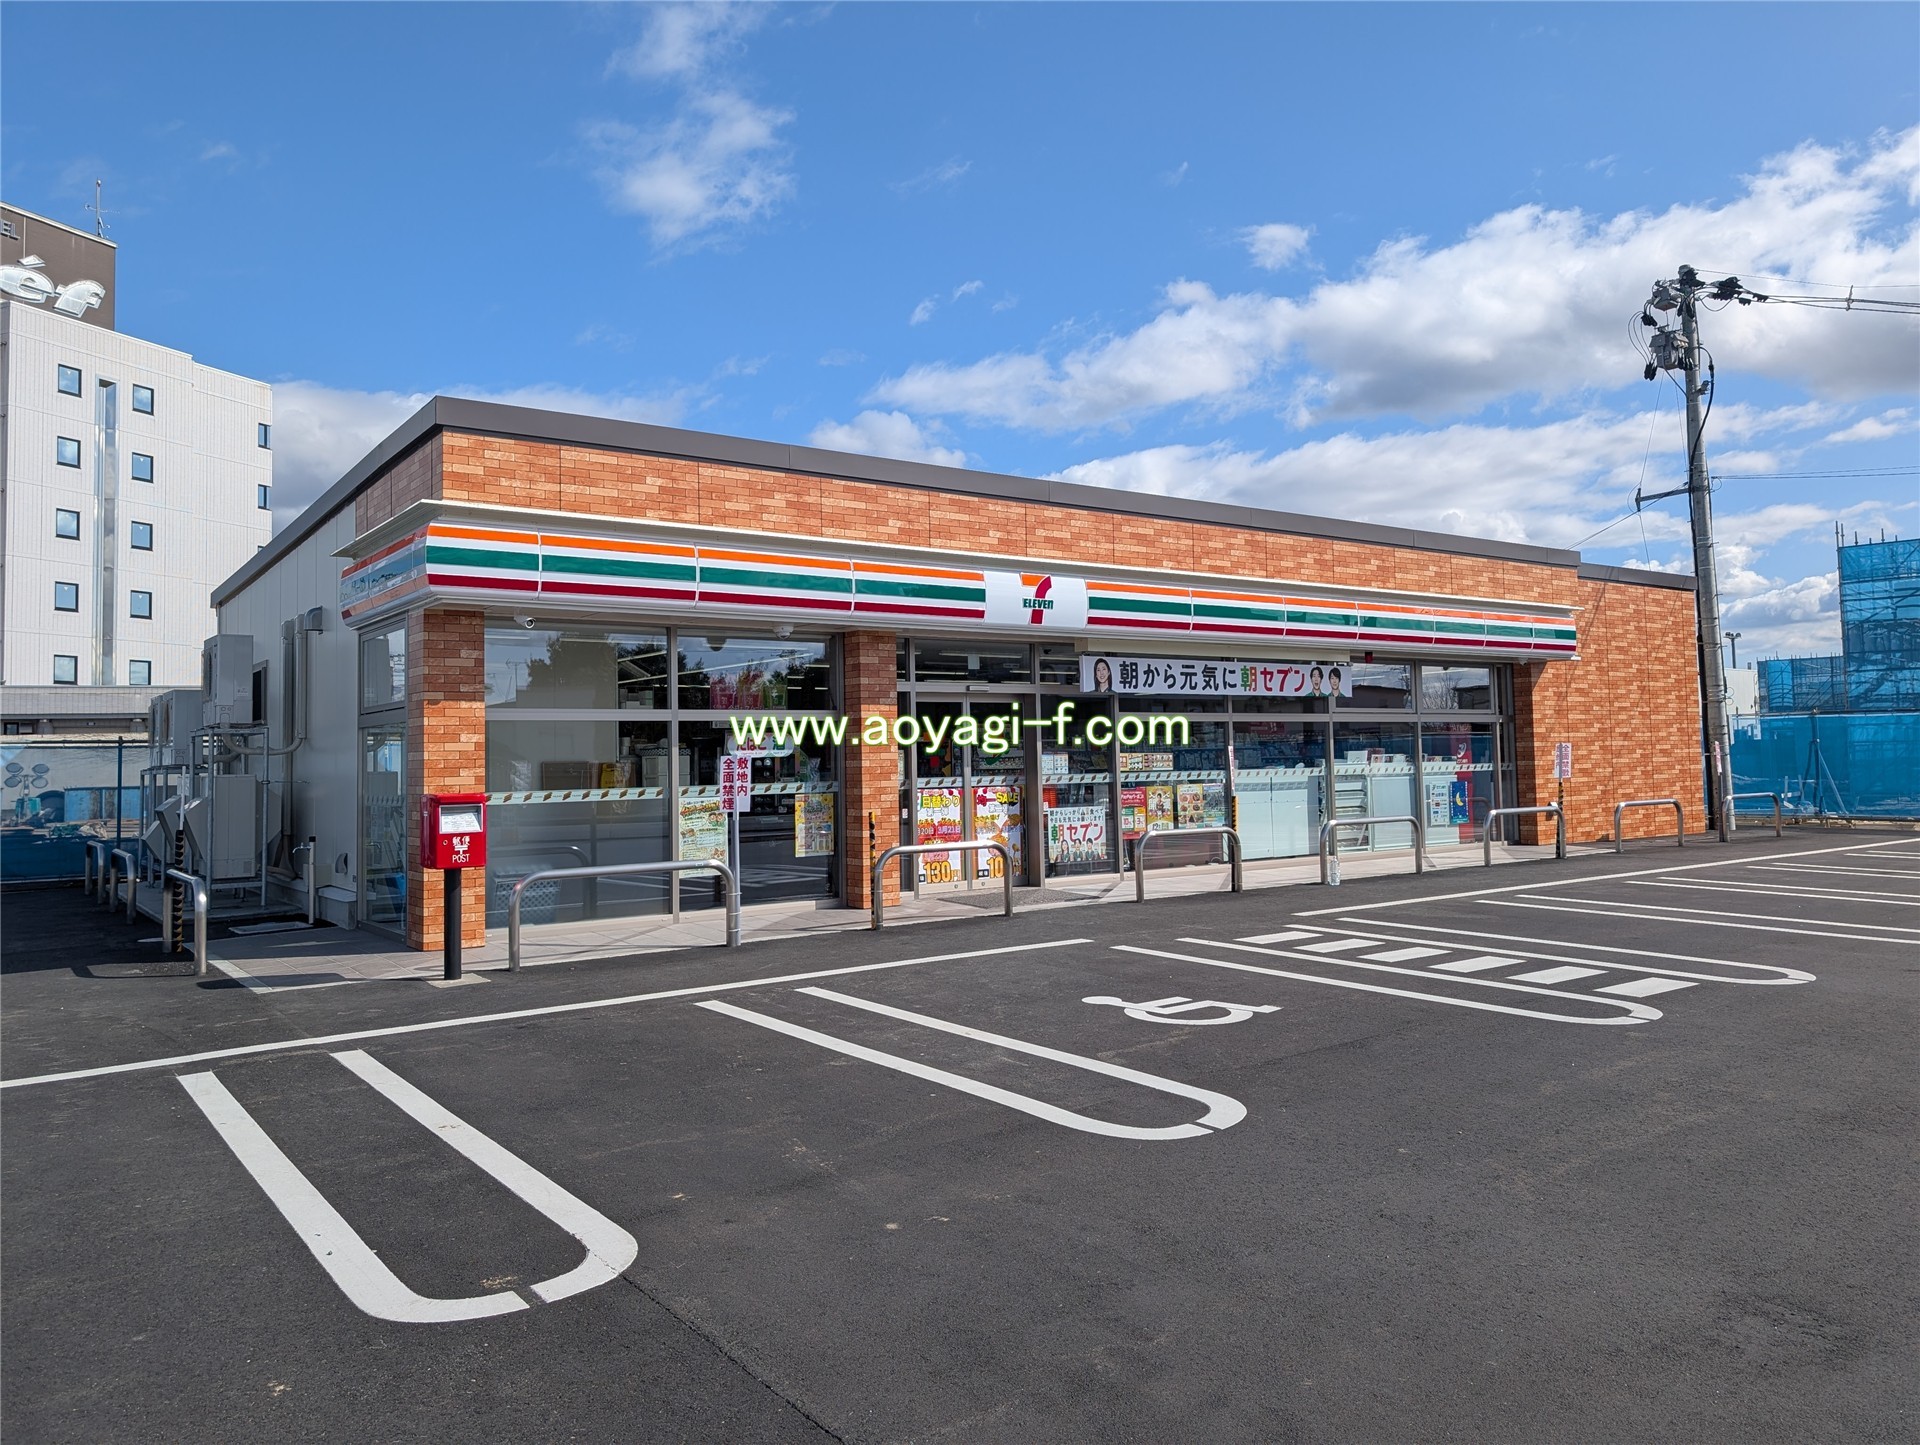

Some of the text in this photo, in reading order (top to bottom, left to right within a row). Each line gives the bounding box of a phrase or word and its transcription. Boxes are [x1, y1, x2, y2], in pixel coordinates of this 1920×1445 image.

[1118, 660, 1305, 693] 朝から元気に朝セブン
[722, 758, 735, 810] 全面禁煙
[736, 757, 748, 797] 敷地内
[1050, 822, 1104, 844] 朝セブン
[452, 854, 470, 863] POST
